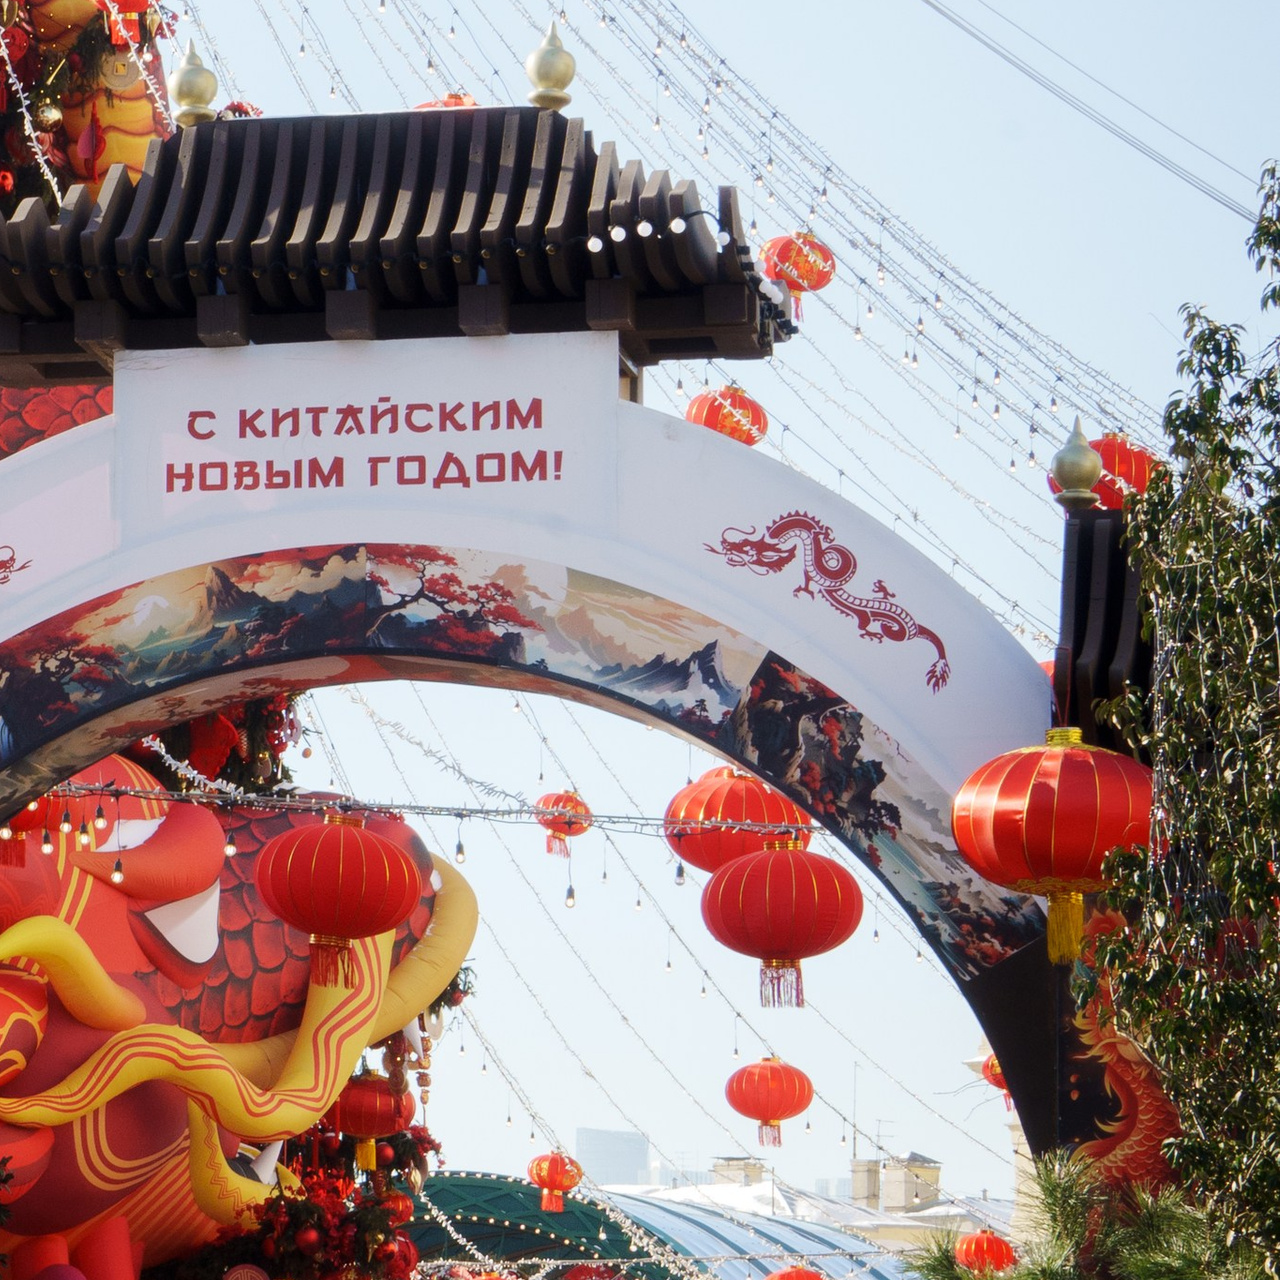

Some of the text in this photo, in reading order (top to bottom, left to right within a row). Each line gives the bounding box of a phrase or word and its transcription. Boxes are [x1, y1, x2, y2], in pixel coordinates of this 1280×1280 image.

[187, 396, 543, 441] С КИТАЙСКИМ
[166, 450, 563, 493] НОВЫМ ГОДОМ!
